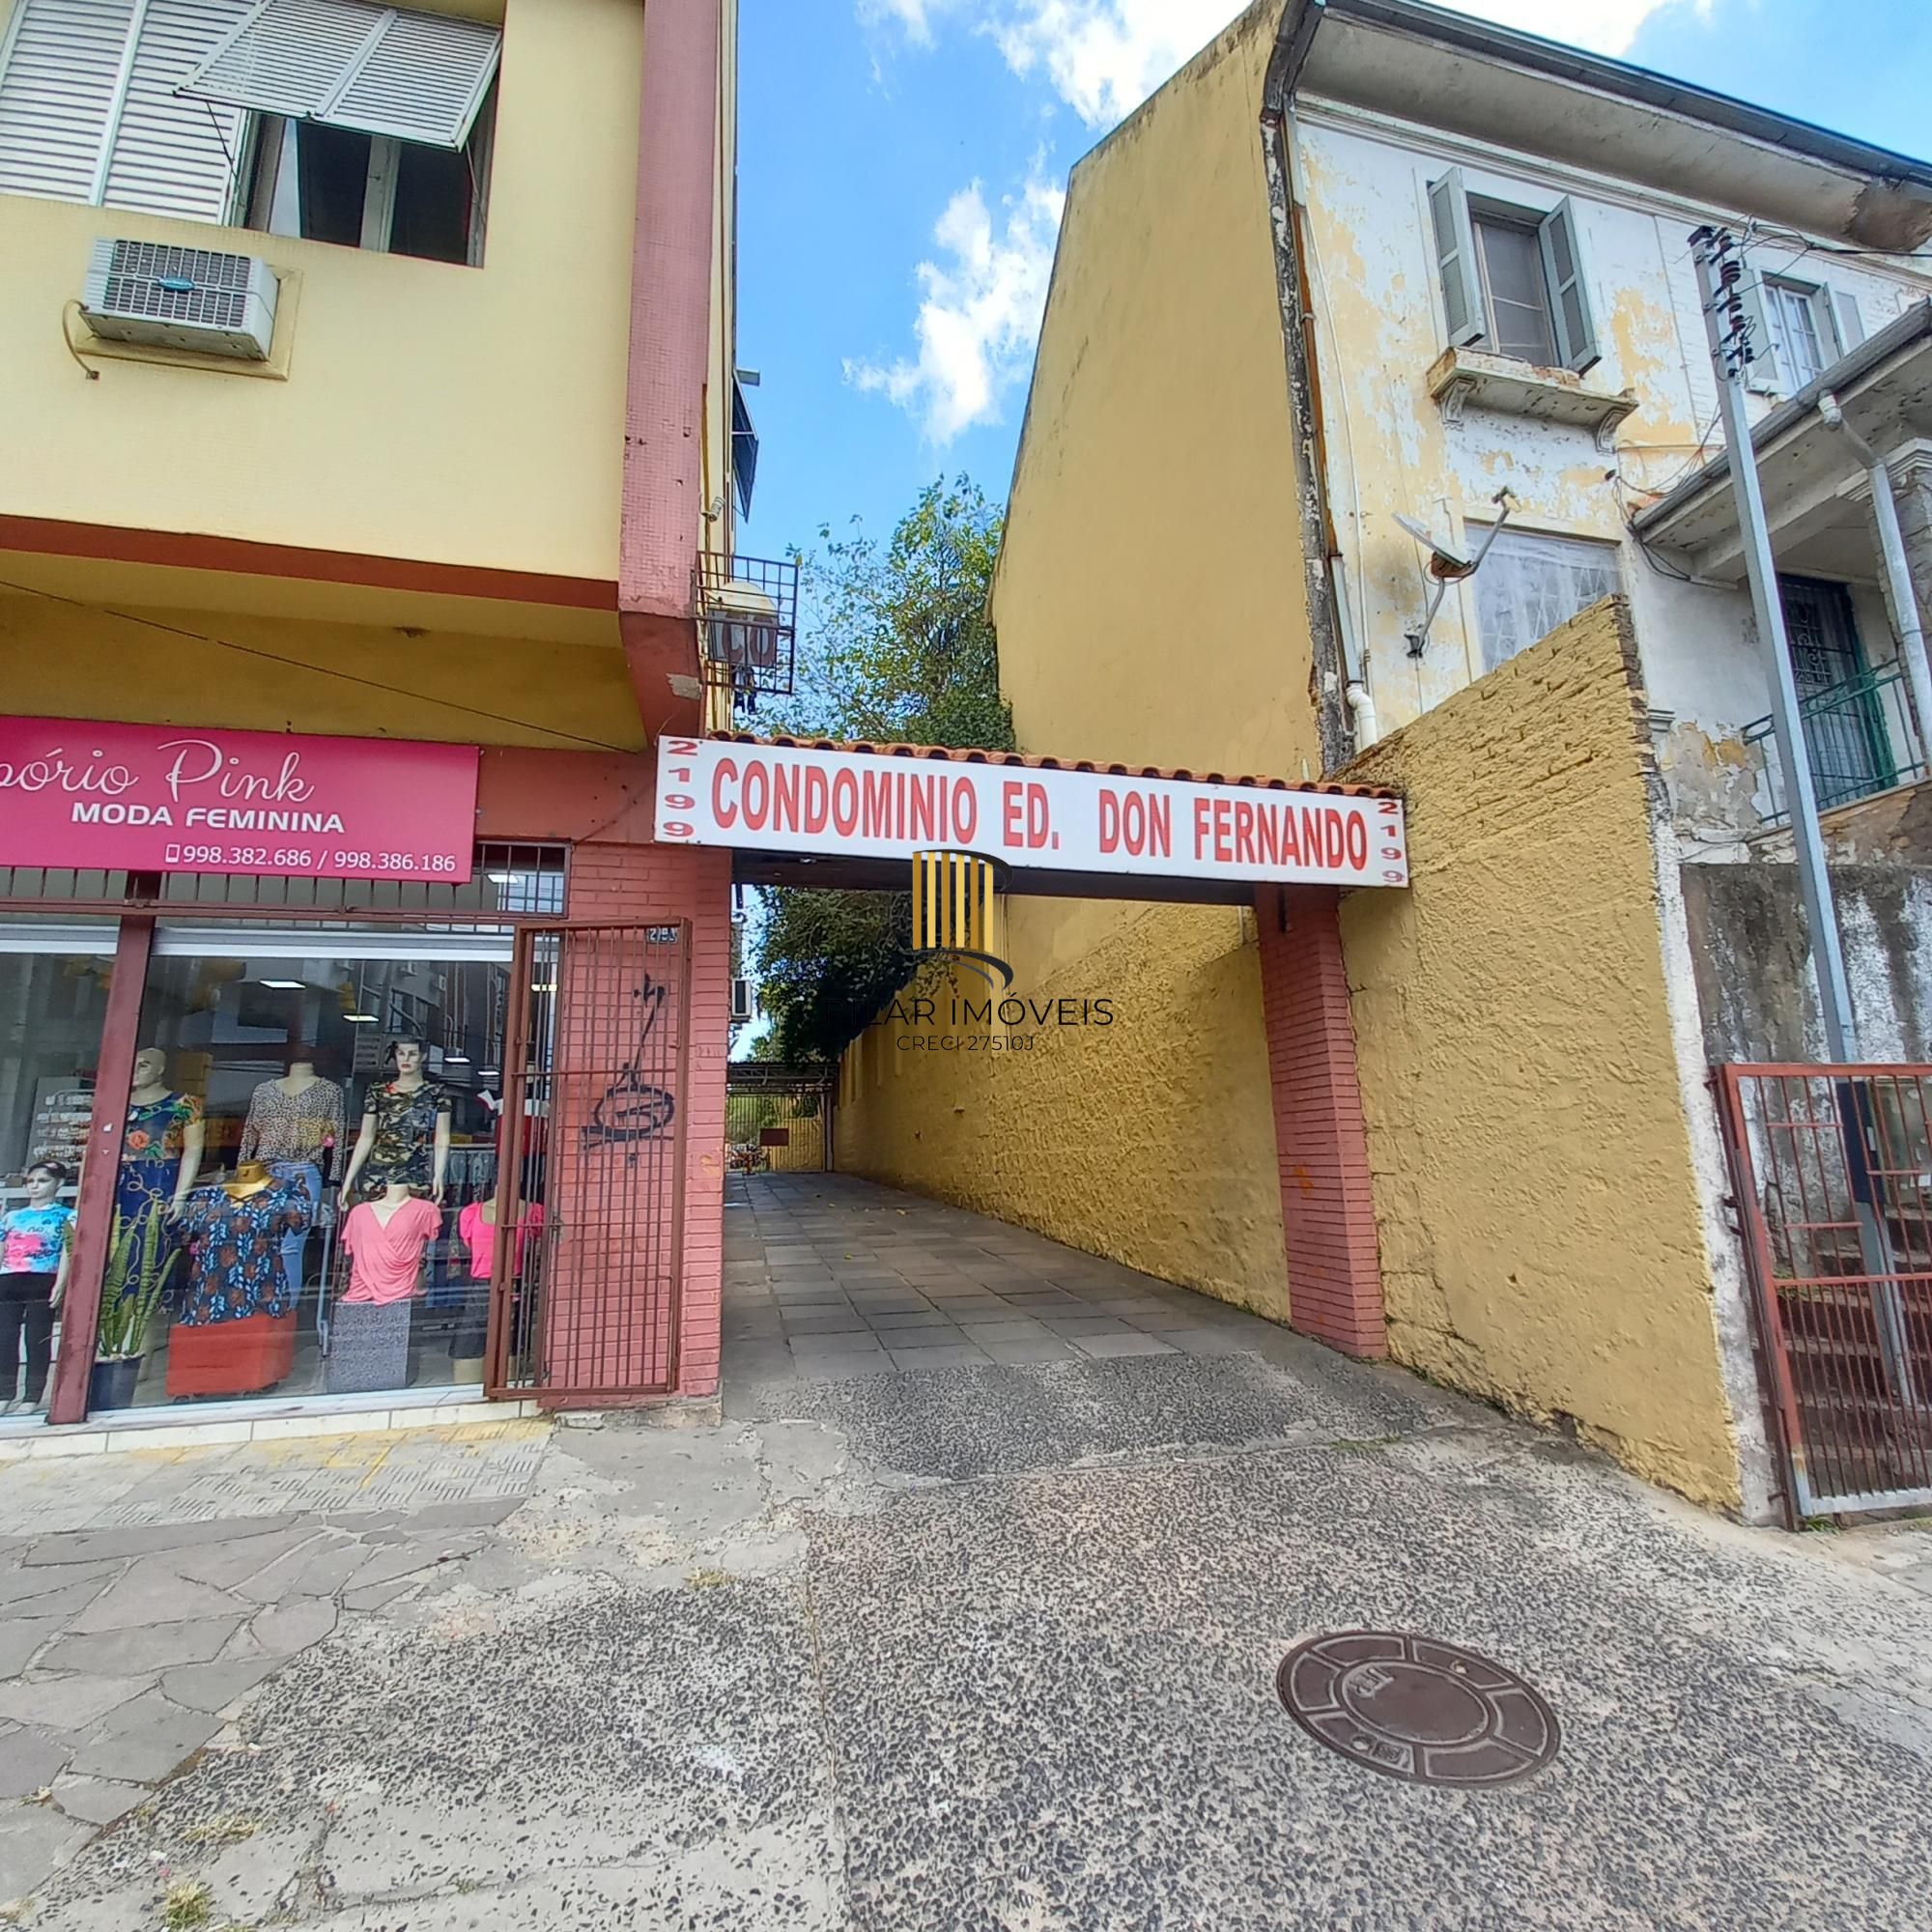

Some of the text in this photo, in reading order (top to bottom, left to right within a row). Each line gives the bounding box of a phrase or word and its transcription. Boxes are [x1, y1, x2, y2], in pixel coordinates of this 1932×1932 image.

[156, 739, 316, 803] Pink
[662, 740, 698, 838] 2199
[71, 803, 346, 834] MODA FEMININA
[711, 757, 1368, 871] CONDOMINIO ED. DON FERNANDO
[183, 846, 457, 872] 998.382.686 / 998.386.186
